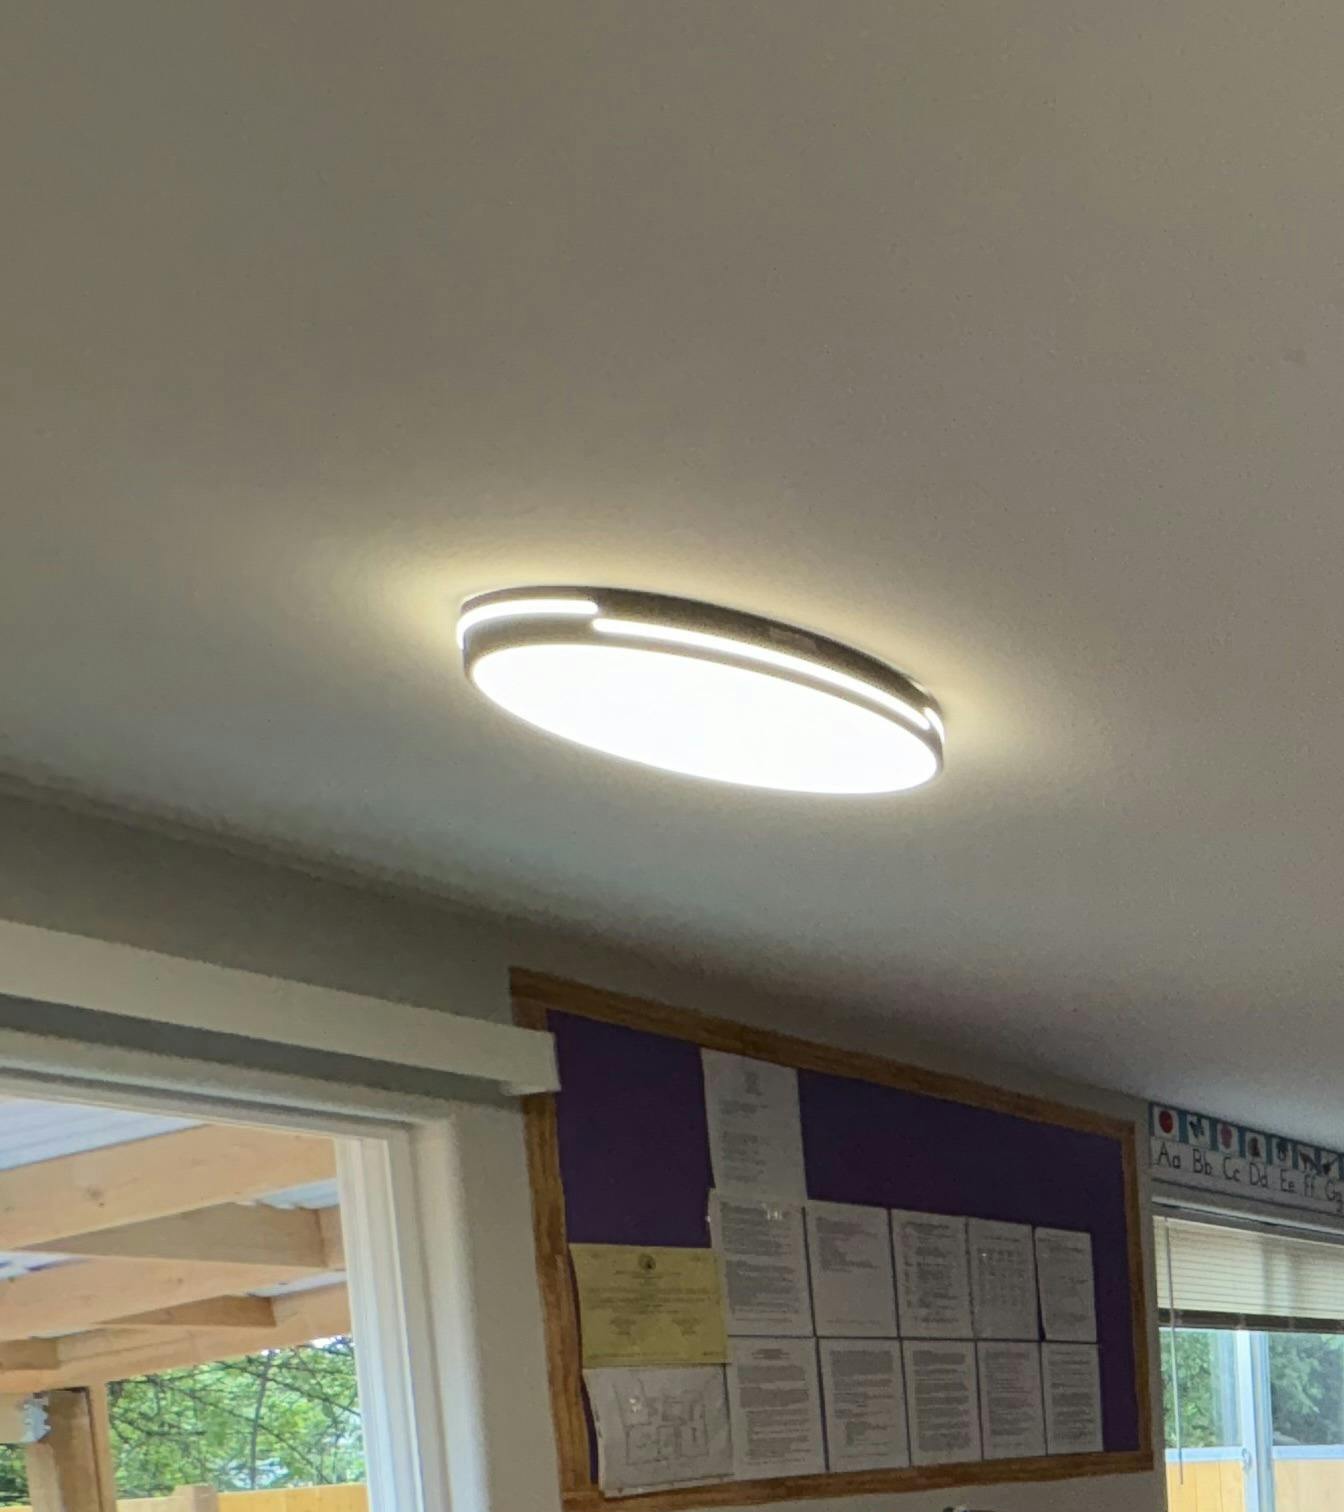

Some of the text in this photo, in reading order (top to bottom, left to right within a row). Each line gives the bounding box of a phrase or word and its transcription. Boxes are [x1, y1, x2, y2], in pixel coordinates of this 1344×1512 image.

[1155, 1142, 1180, 1168] Aa
[1192, 1148, 1212, 1176] Bb
[1222, 1156, 1240, 1181] Cc
[1249, 1162, 1267, 1187] Dd
[1280, 1169, 1297, 1193] Ee
